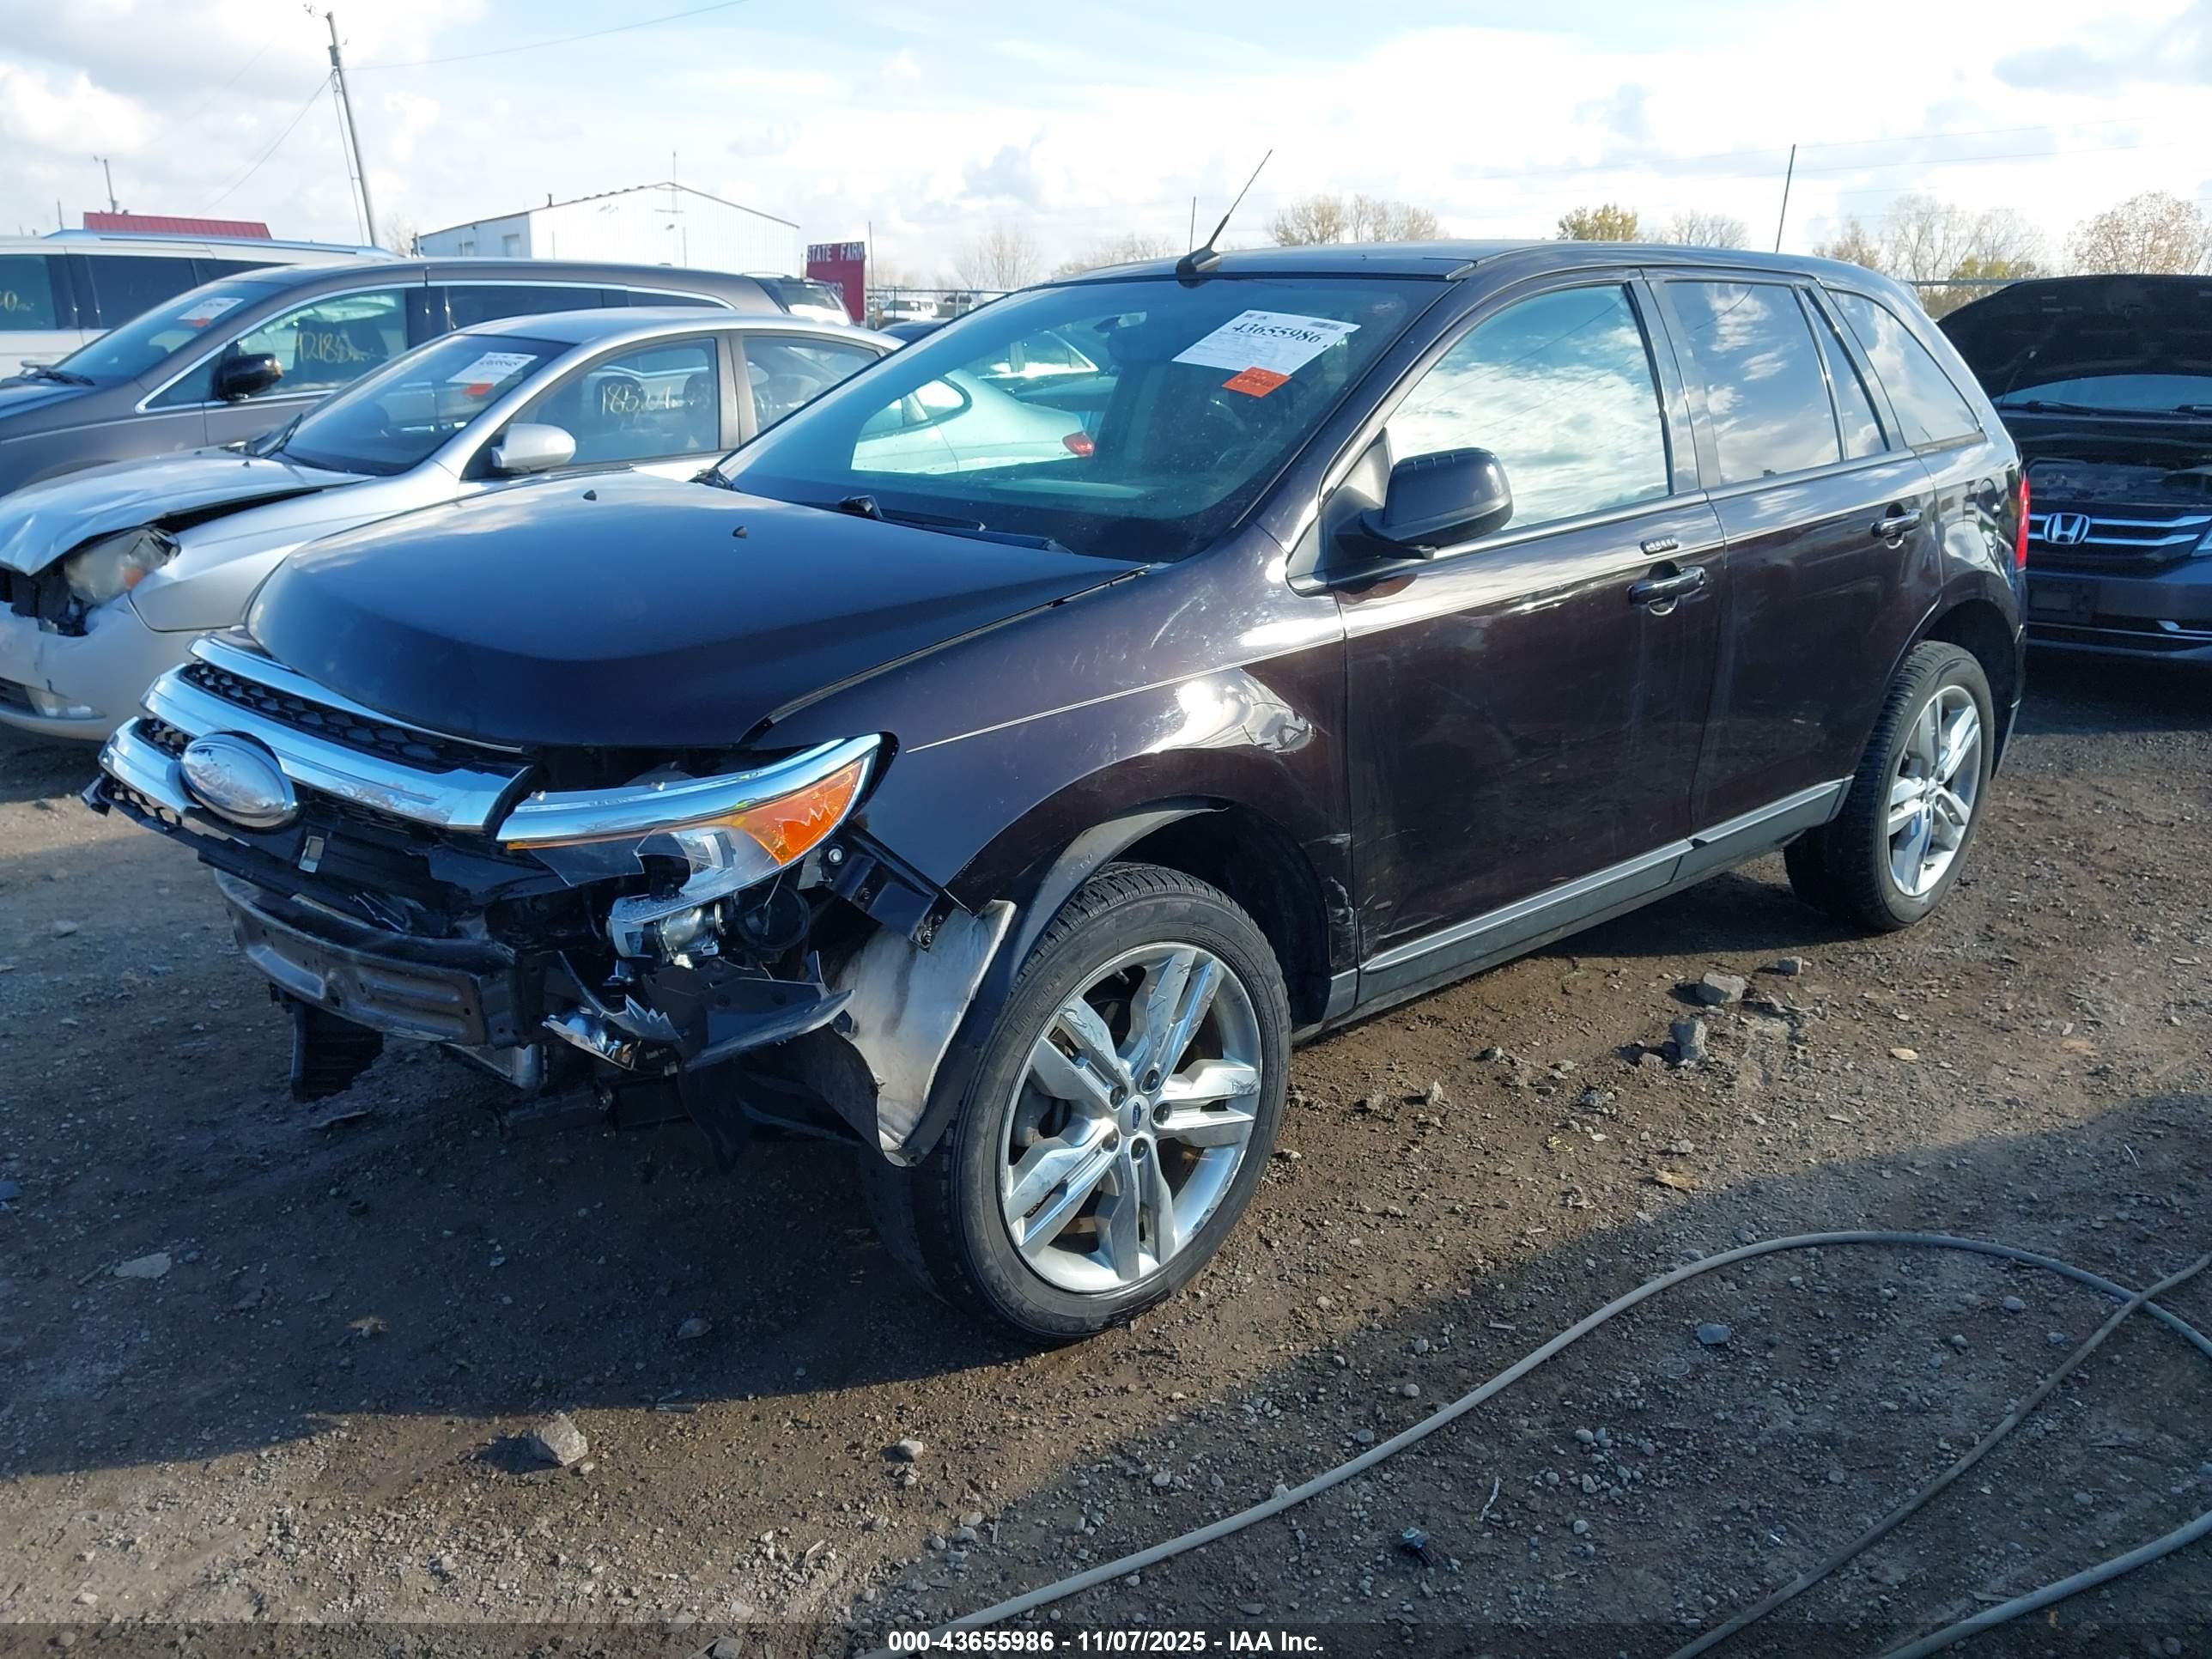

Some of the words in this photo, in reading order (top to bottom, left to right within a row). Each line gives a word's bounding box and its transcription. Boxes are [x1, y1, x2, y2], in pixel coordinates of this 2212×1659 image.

[807, 245, 832, 263] STATE
[840, 241, 864, 261] FARM
[1232, 323, 1327, 343] 43655986
